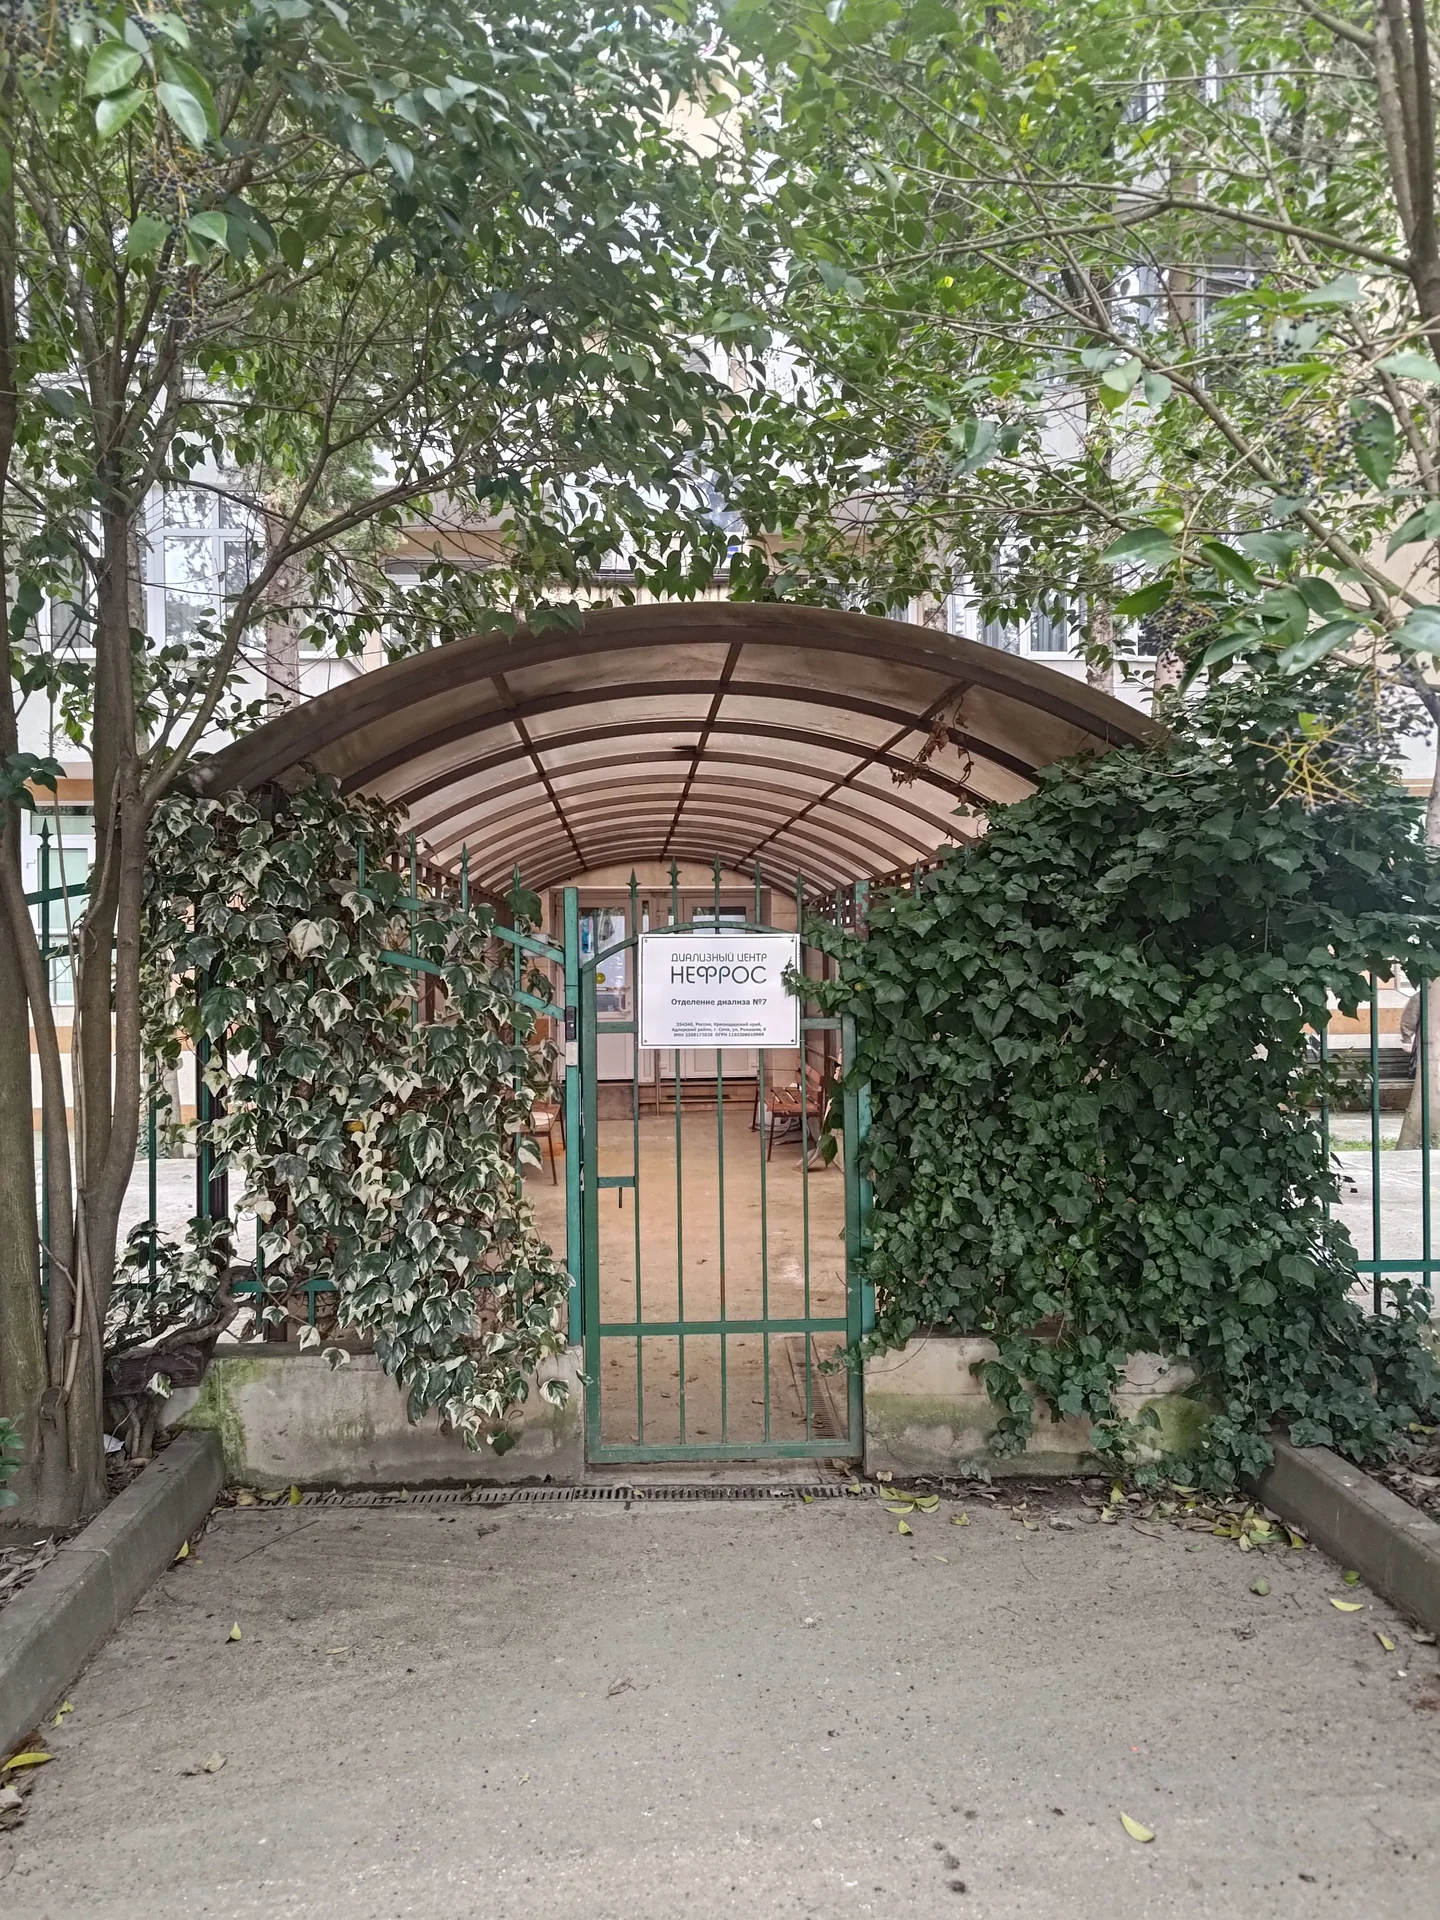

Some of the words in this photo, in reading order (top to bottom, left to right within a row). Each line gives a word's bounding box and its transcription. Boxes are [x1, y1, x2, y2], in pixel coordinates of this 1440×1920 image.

[671, 952, 734, 963] ДИАЛИЗНЫЙ
[737, 953, 768, 963] ЦЕНТР
[671, 966, 767, 984] НЕФРОС
[671, 998, 716, 1006] Отделение
[717, 999, 751, 1007] диализа
[752, 998, 767, 1006] №7
